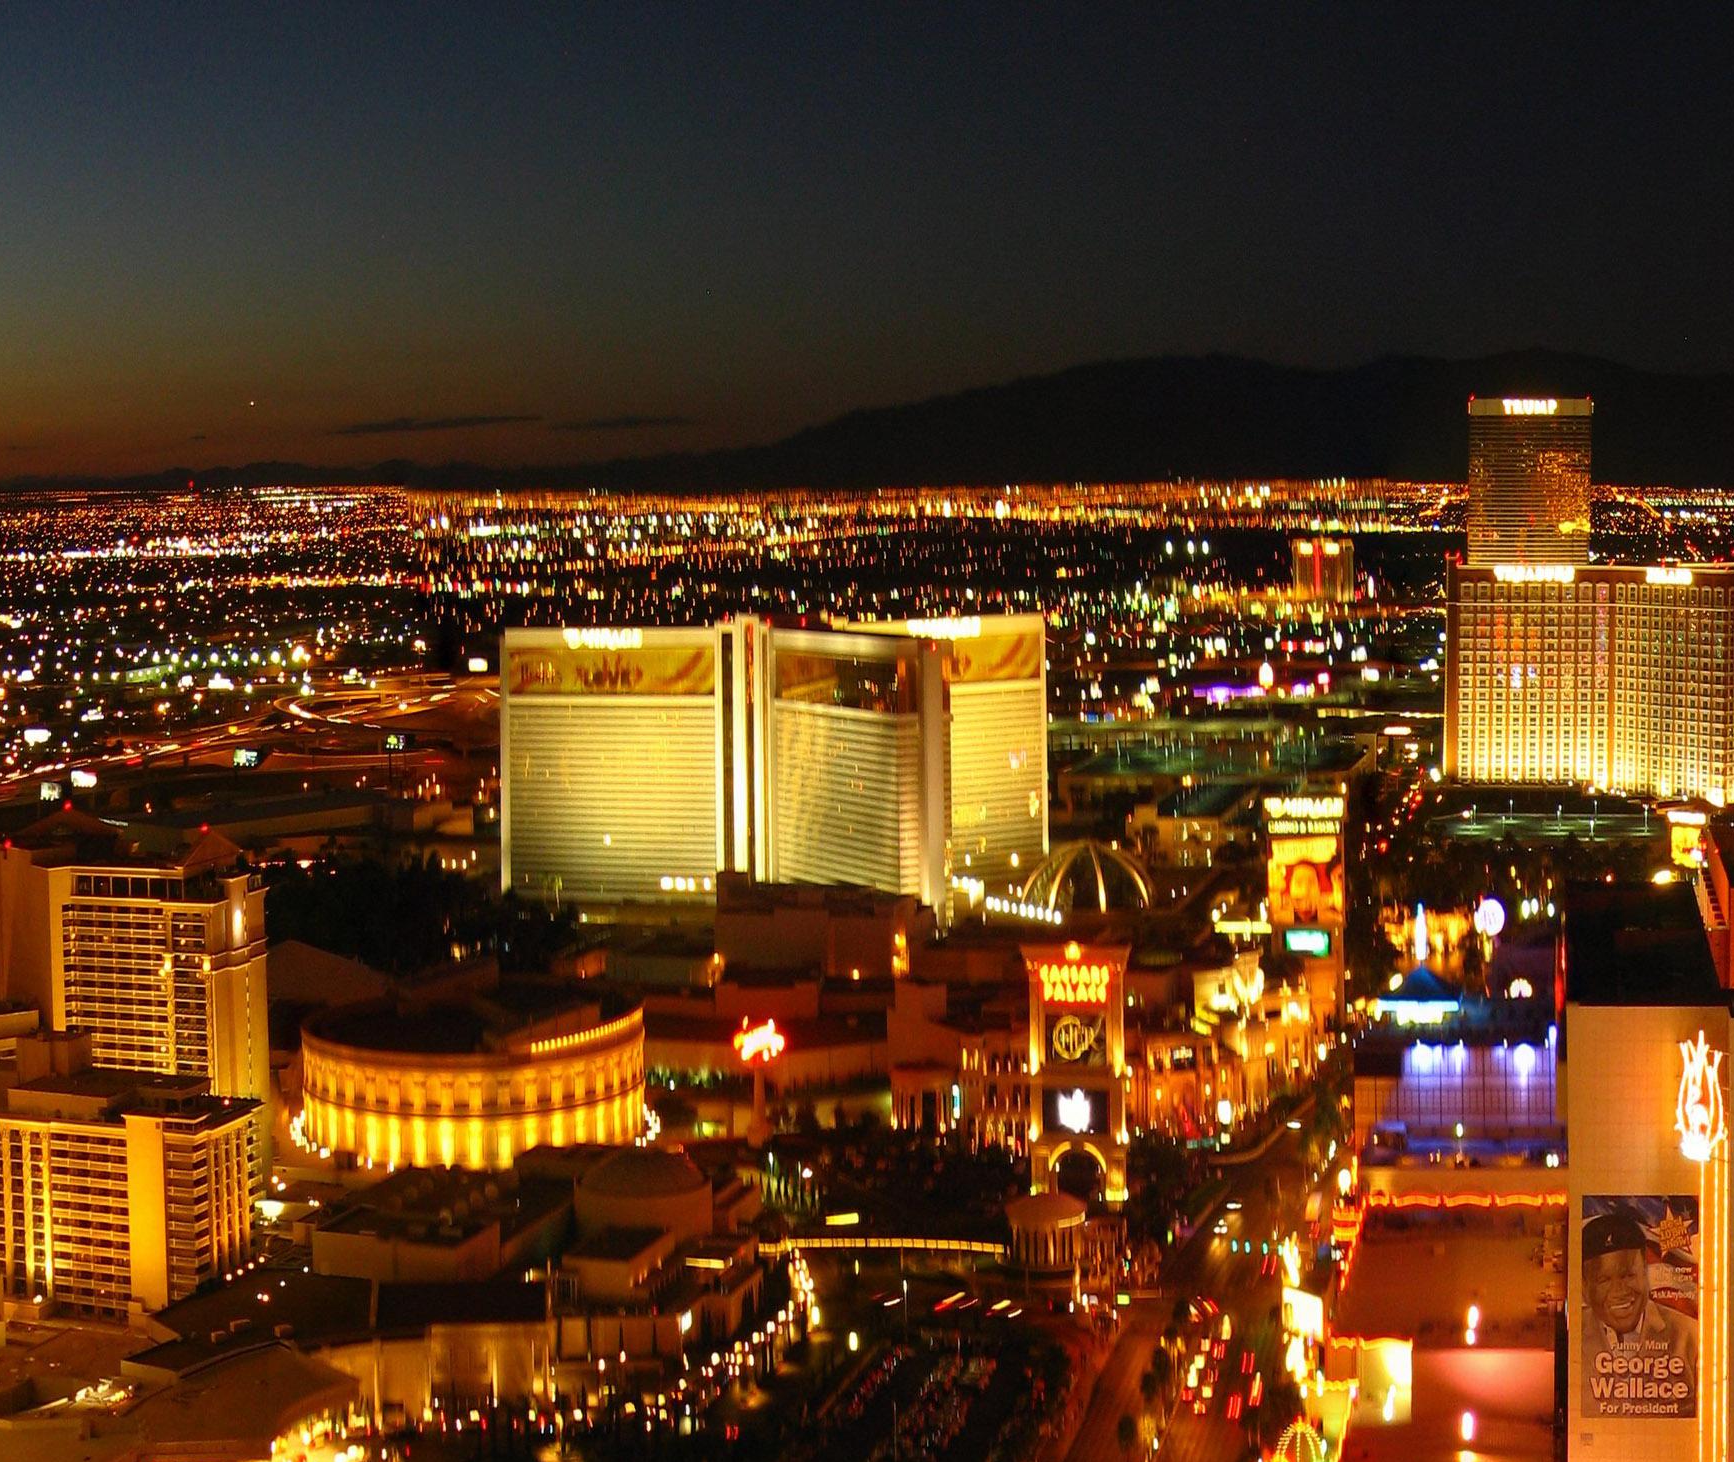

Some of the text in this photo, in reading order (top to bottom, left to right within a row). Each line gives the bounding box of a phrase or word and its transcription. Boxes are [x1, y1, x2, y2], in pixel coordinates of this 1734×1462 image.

[1502, 399, 1558, 415] TRUMP
[1040, 964, 1109, 984] CAESARS
[1044, 981, 1106, 1003] PALACE
[1595, 1352, 1684, 1379] George
[1590, 1377, 1688, 1399] Wallace
[1600, 1402, 1679, 1414] For President
